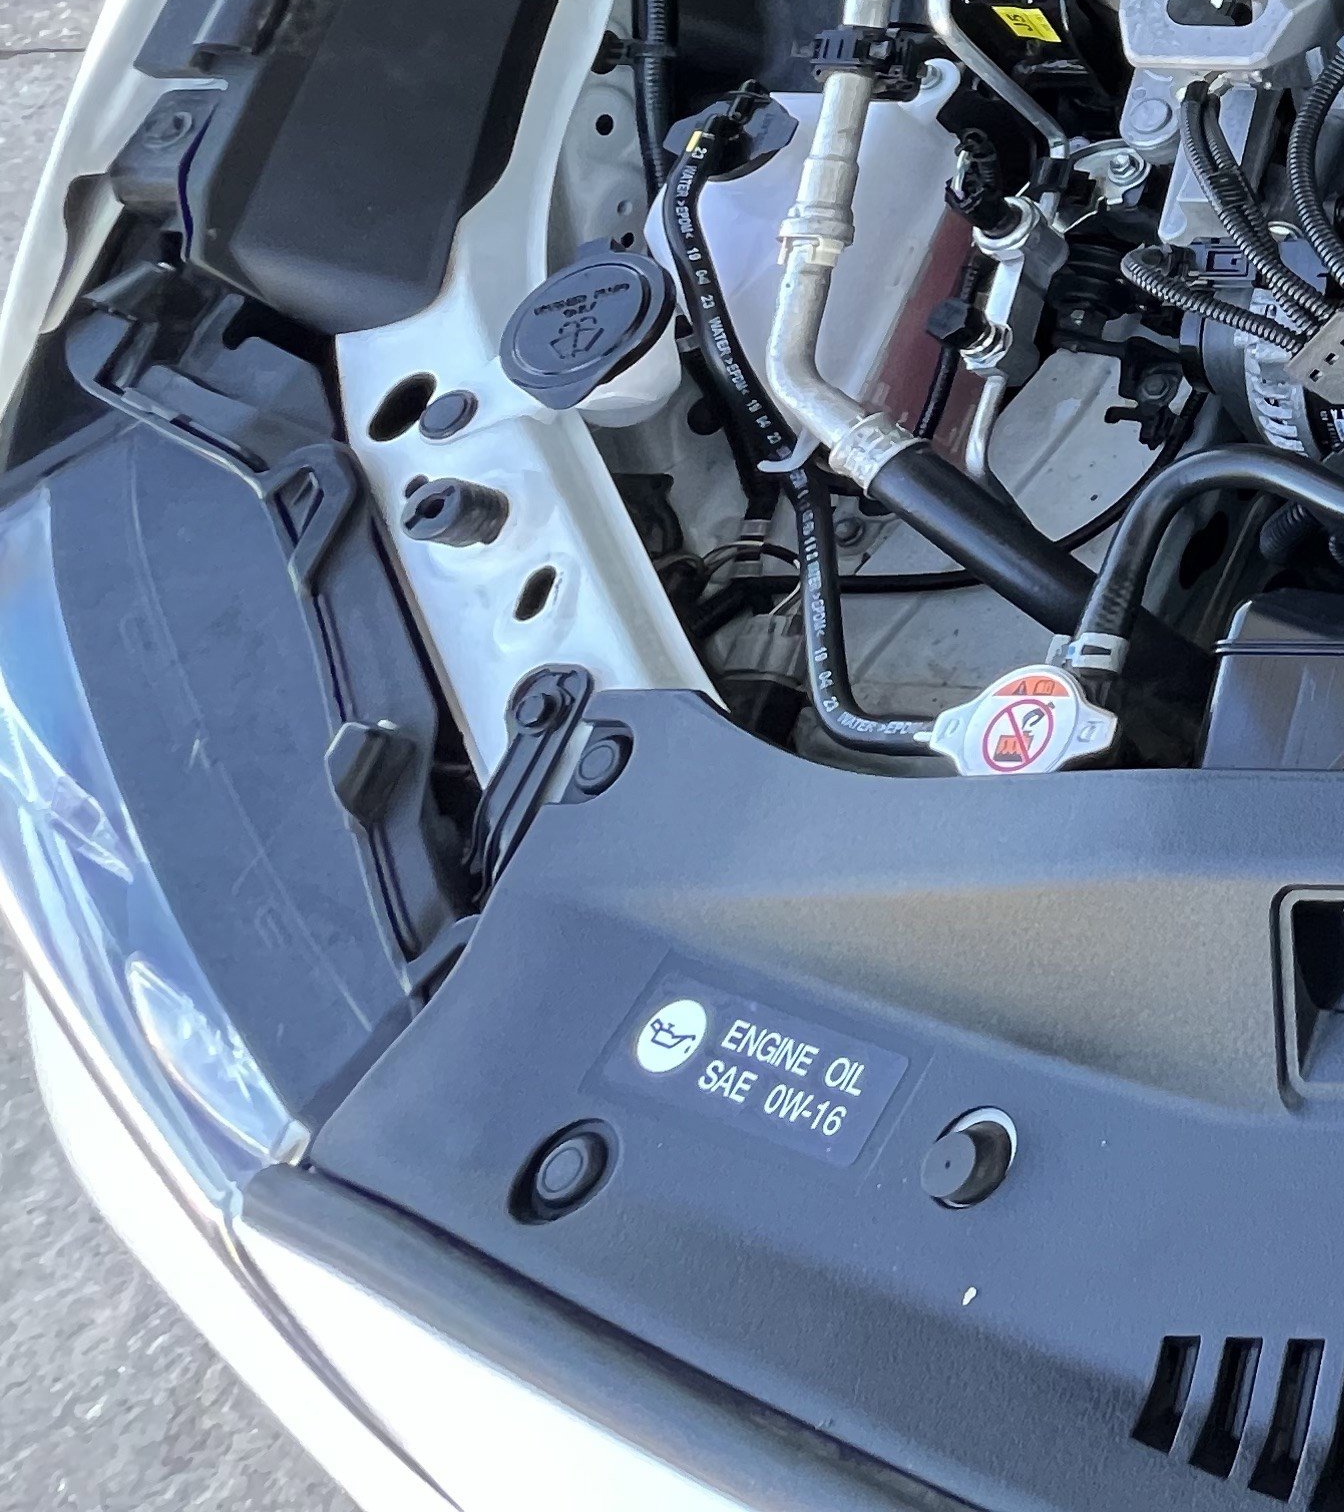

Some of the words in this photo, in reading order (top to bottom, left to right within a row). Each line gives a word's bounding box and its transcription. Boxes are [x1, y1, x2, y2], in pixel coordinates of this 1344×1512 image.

[676, 165, 698, 198] WATER
[700, 294, 716, 309] 23
[708, 316, 732, 357] WATER
[837, 711, 878, 733] WATER
[721, 1019, 820, 1077] ENGINE
[824, 1057, 865, 1097] OIL
[697, 1059, 759, 1103] SAE
[763, 1084, 848, 1136] 0W-16
